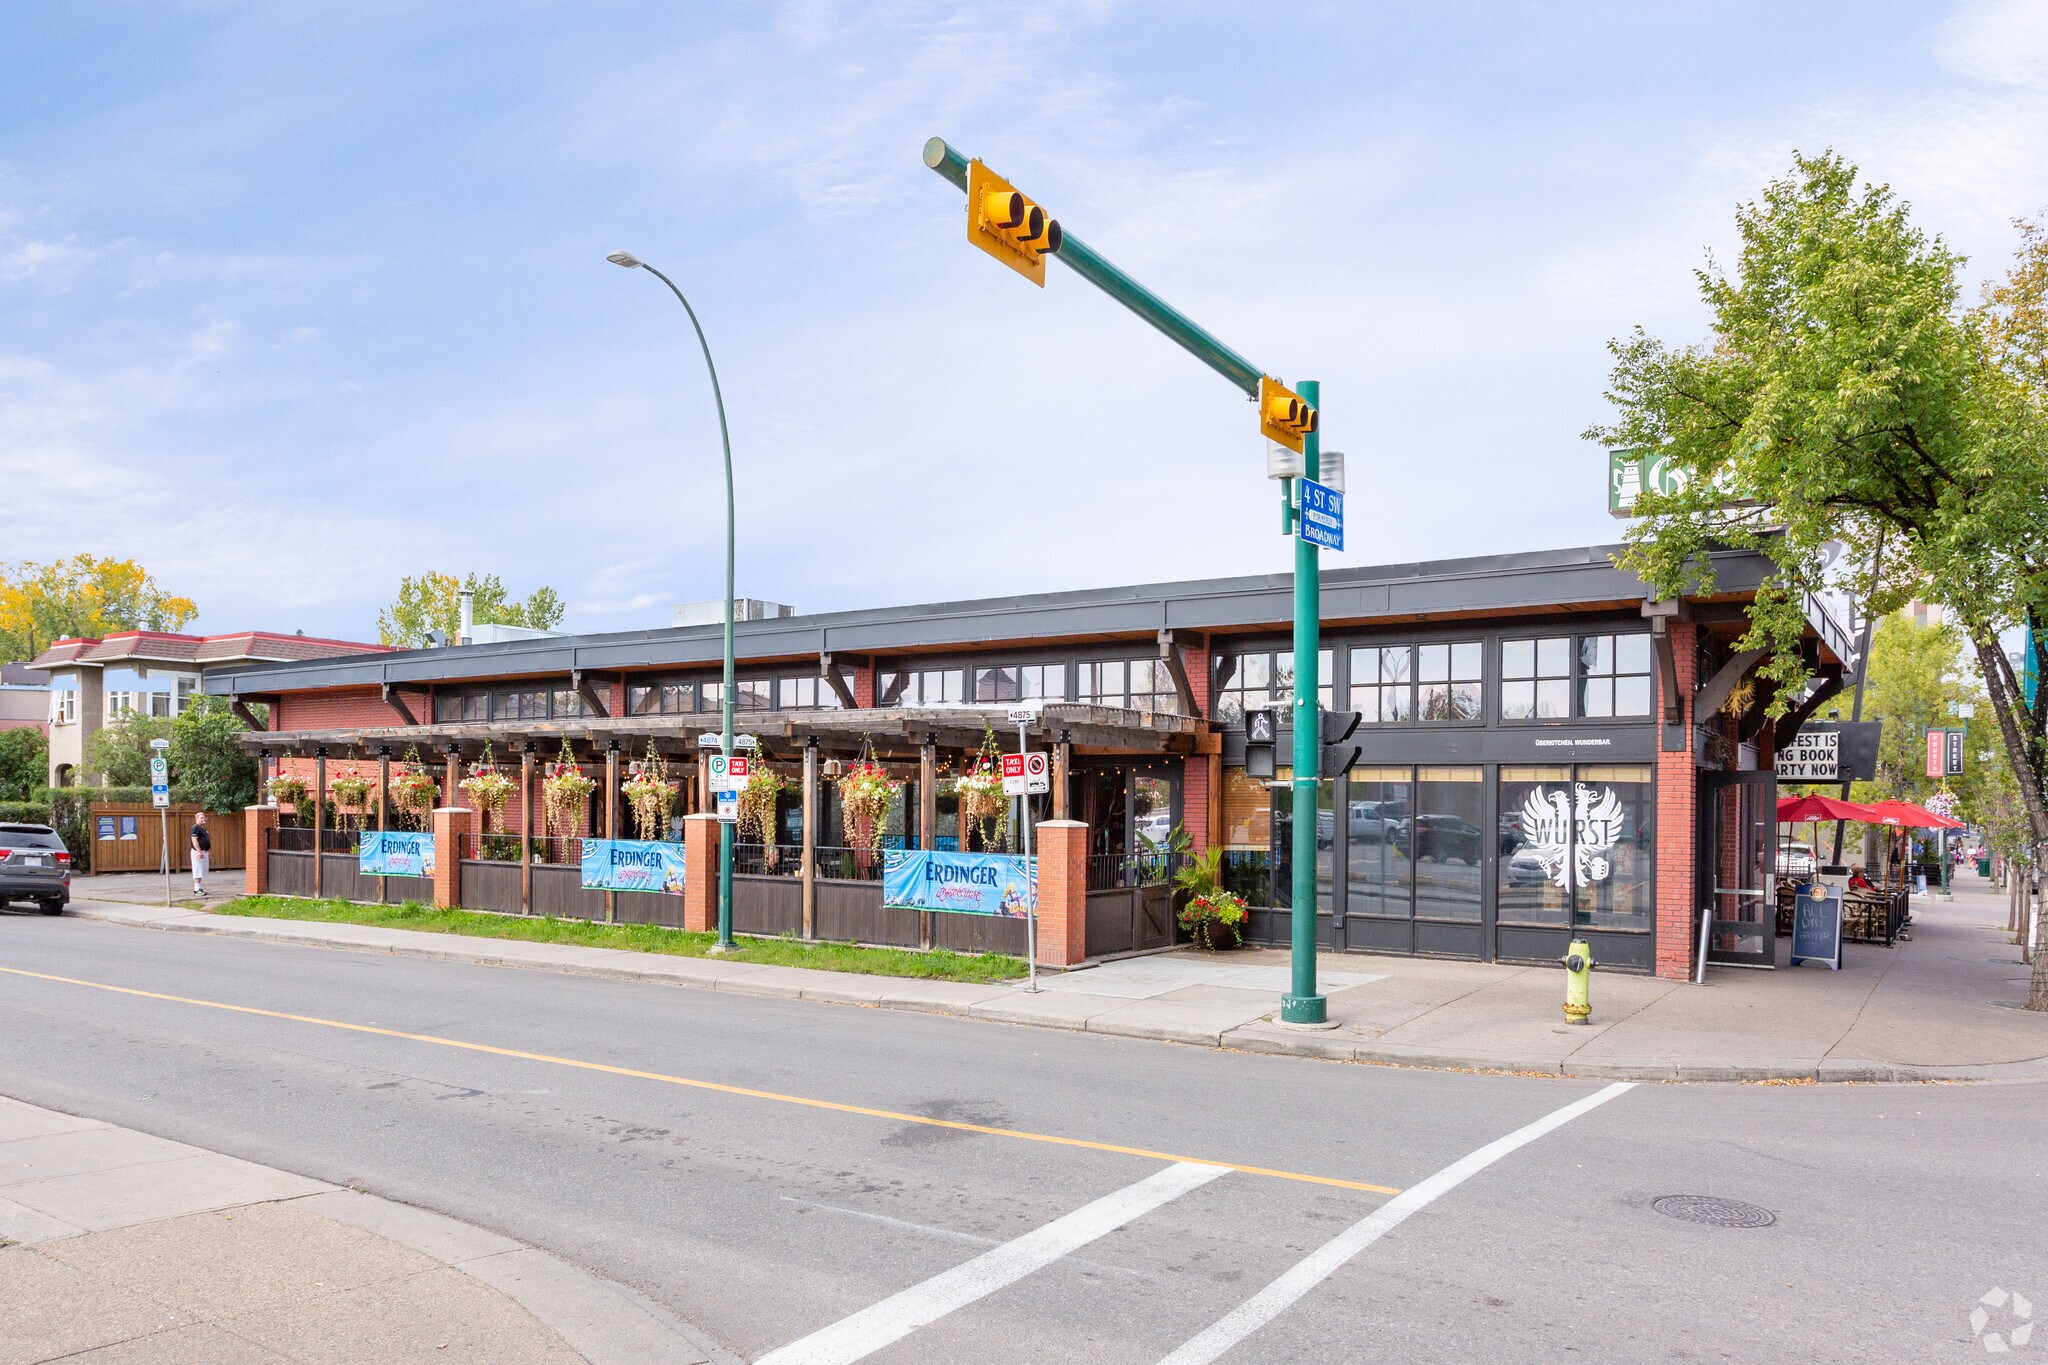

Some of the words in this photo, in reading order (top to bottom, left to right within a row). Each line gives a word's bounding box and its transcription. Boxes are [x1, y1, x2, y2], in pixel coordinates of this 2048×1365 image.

[1304, 484, 1311, 504] 4
[1328, 494, 1341, 515] SW
[1305, 523, 1341, 547] BROADWAY
[1012, 710, 1031, 719] 4875
[702, 736, 718, 744] 4874
[737, 737, 752, 746] 4875
[1825, 734, 1837, 747] IS
[1800, 749, 1835, 761] BOOK
[1005, 758, 1020, 766] TAXI
[1005, 766, 1022, 774] ONLY
[1811, 763, 1837, 776] NOW
[1533, 818, 1613, 846] WURST
[381, 838, 421, 857] ERDINGER
[609, 848, 663, 870] ERDINGER
[925, 861, 999, 888] ERDINGER
[1802, 903, 1827, 918] ALL
[1801, 918, 1824, 929] DAY
